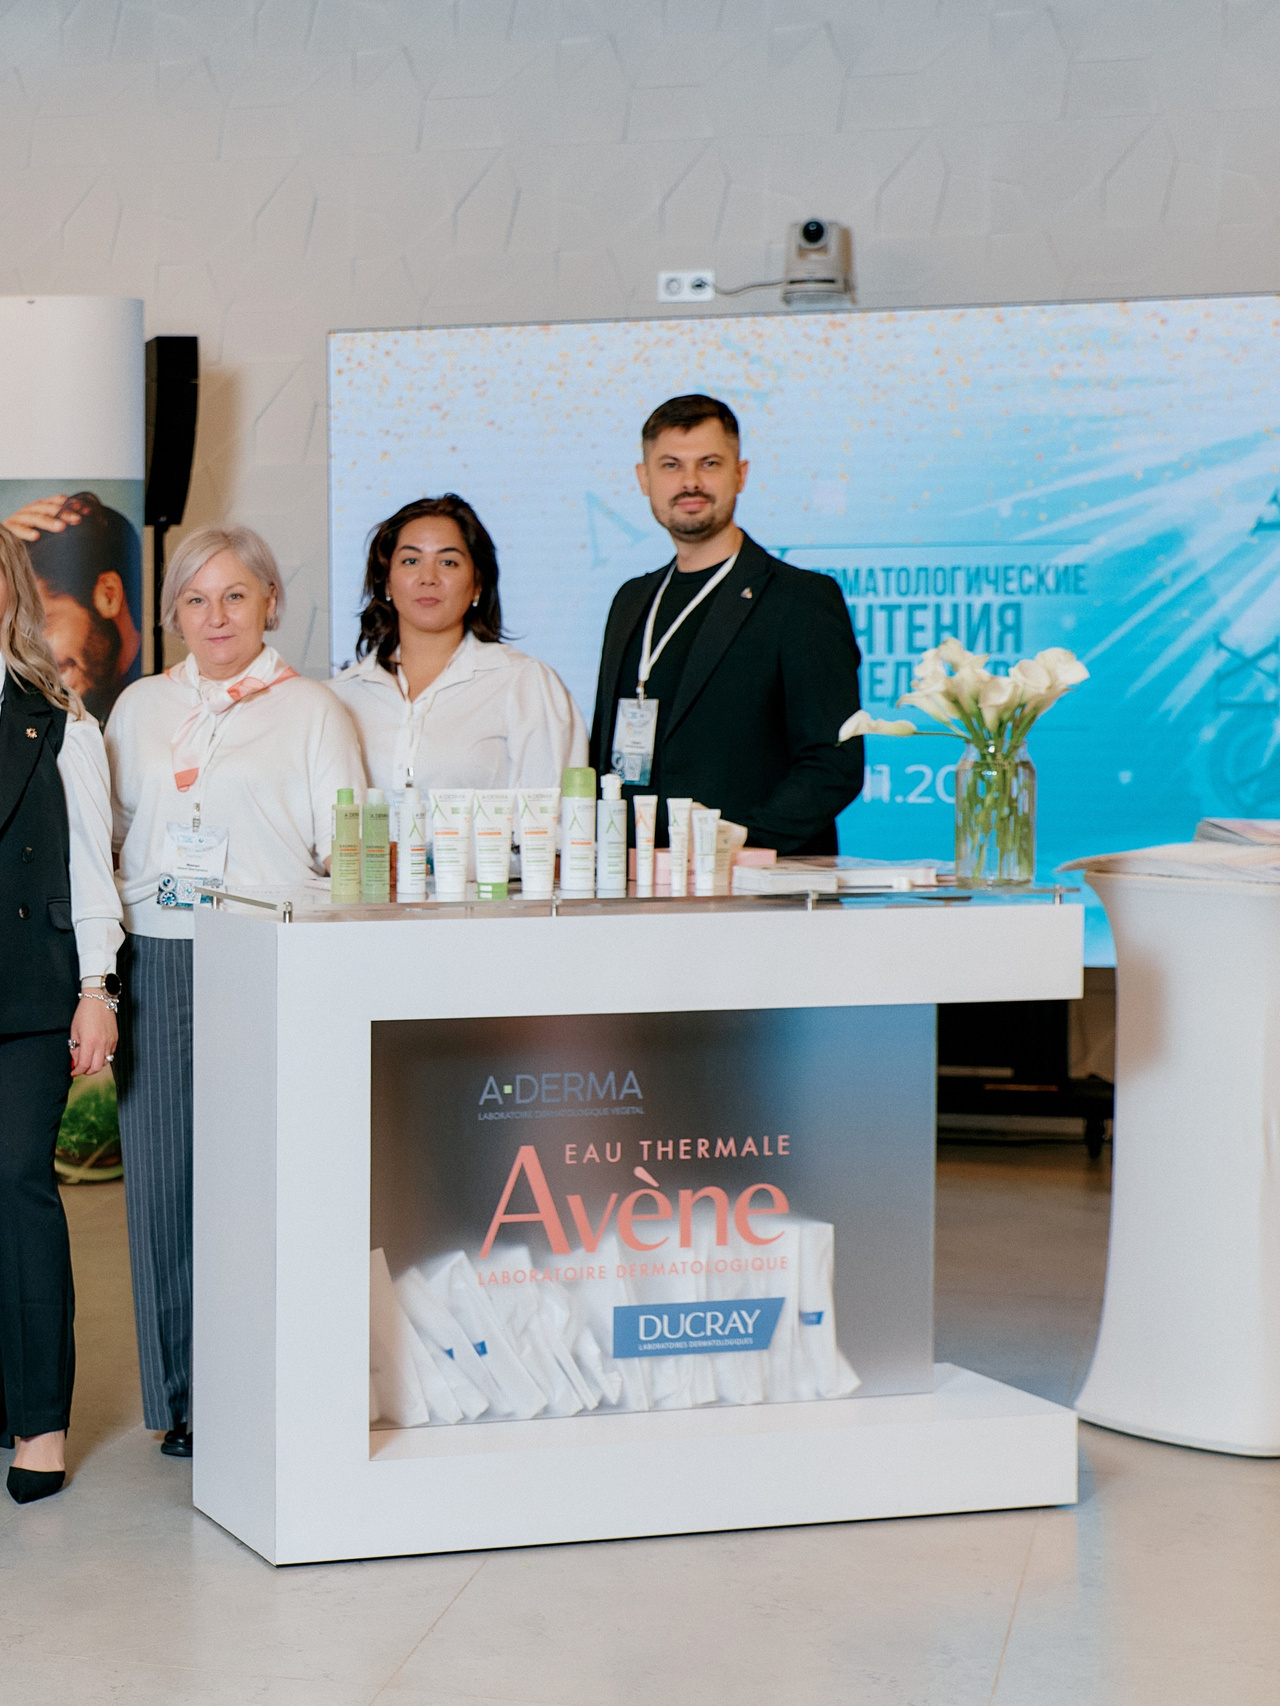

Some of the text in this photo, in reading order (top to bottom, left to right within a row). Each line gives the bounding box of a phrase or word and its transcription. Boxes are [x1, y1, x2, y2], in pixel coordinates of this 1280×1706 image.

[565, 1134, 791, 1165] EAU THERMALE
[479, 1145, 790, 1259] Avène
[478, 1256, 789, 1286] LABORATOIRE DERMATOLOGIQUE
[638, 1309, 761, 1341] DUCRAY
